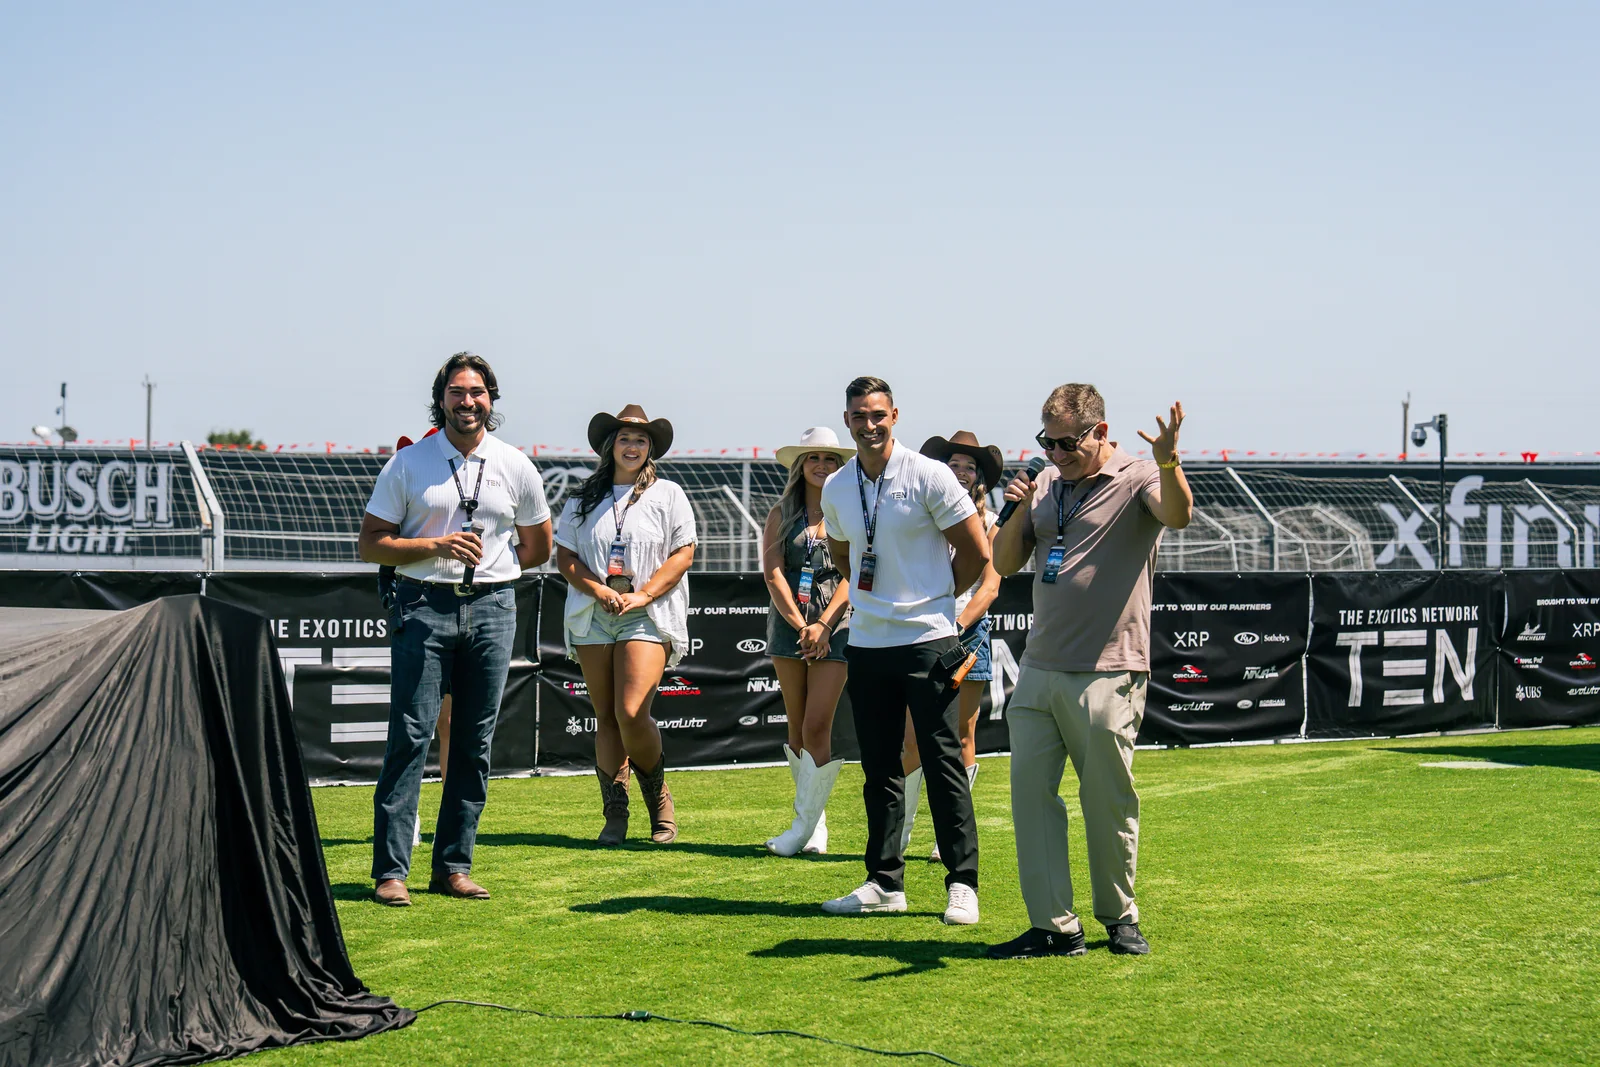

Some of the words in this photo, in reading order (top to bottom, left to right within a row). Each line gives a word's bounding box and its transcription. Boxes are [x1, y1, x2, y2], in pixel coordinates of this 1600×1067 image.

[0, 460, 174, 528] BUSCH
[892, 492, 908, 500] TEN
[26, 523, 132, 553] LIGHT
[1166, 603, 1179, 611] TO
[1180, 603, 1197, 611] YOU
[1196, 603, 1209, 611] BY
[1209, 603, 1228, 611] OUR
[1228, 603, 1272, 611] PARTNERS
[1536, 598, 1565, 606] BROUGHT
[687, 607, 702, 615] BY
[703, 607, 727, 615] OUR
[728, 606, 769, 615] PARTNE
[1339, 609, 1364, 626] THE
[1367, 607, 1417, 625] EXOTICS
[1422, 605, 1479, 623] NETWORK
[299, 618, 388, 639] EXOTICS
[1572, 622, 1600, 638] XRP
[1173, 631, 1210, 648] XRP
[1263, 633, 1290, 643] Sotheby's
[1335, 627, 1479, 707] TEN
[1525, 686, 1542, 699] UBS
[656, 717, 708, 729] evoluto
